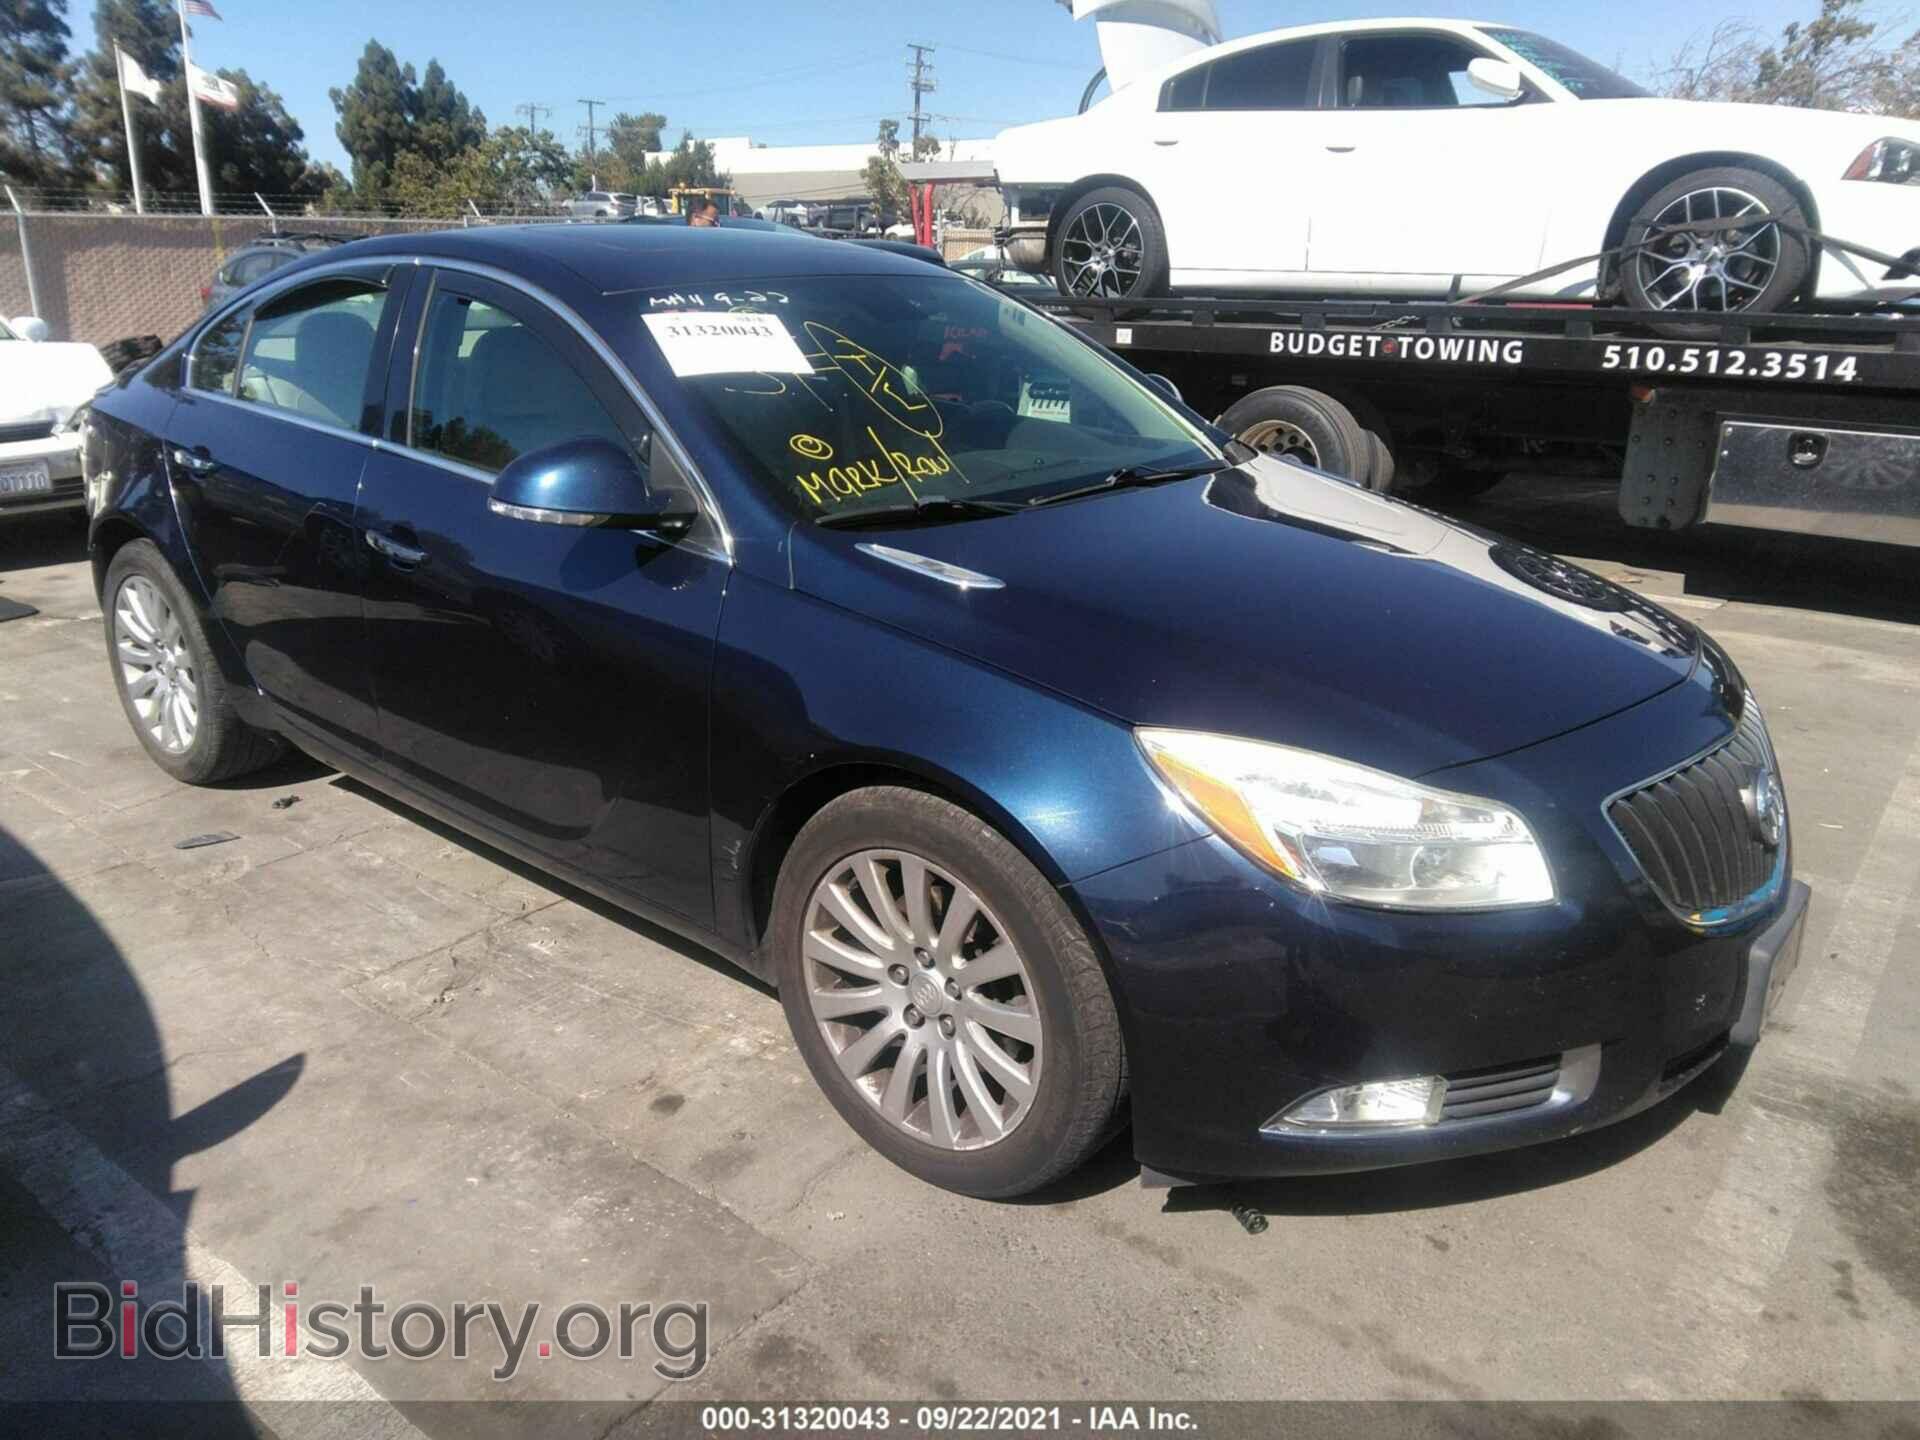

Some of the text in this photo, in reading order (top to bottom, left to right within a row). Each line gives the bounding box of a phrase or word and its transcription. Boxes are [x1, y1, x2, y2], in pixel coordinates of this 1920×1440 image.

[665, 324, 775, 338] 31320043
[1269, 331, 1524, 364] BUDGET TOWING
[1601, 344, 1858, 382] 510.512.3514
